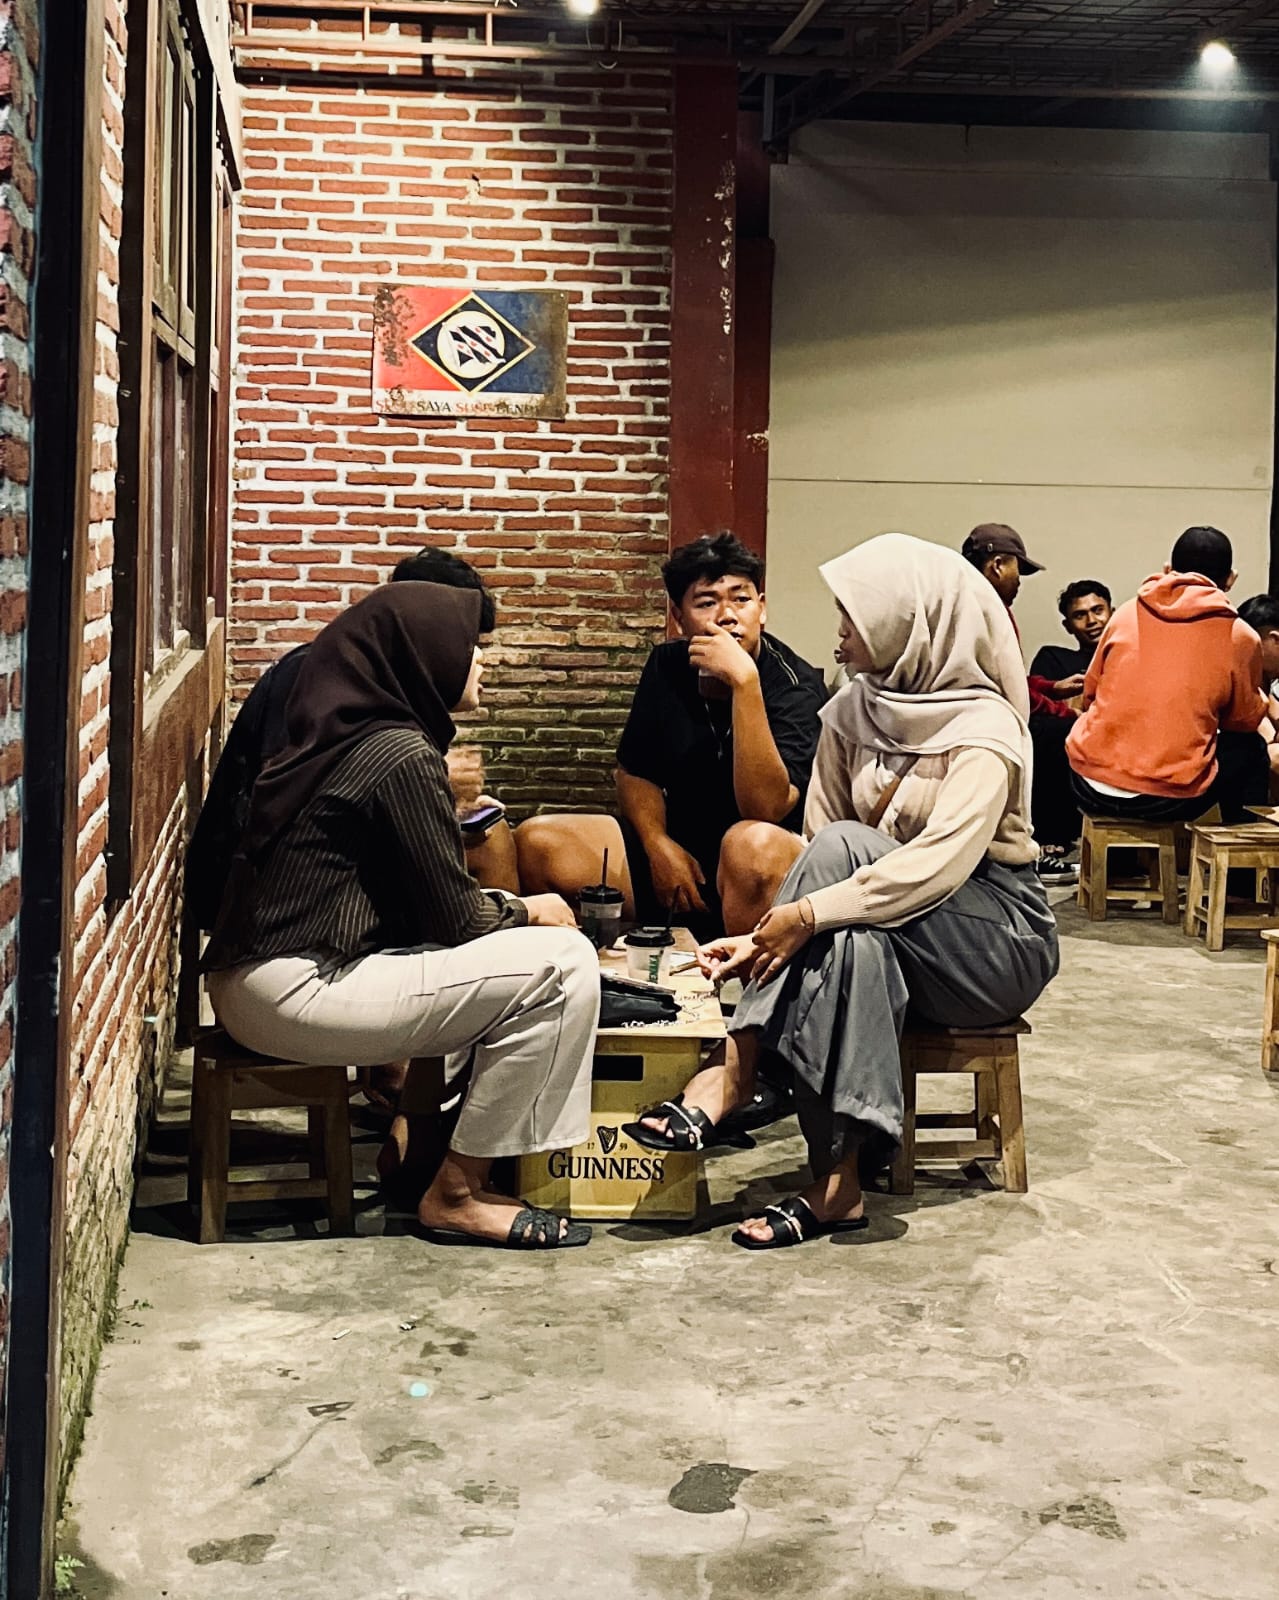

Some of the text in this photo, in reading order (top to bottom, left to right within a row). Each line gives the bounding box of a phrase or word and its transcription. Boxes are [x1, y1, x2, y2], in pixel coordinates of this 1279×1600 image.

[417, 401, 451, 413] SAYA
[587, 1142, 628, 1150] 17 59
[548, 1151, 665, 1181] GUINNESS
